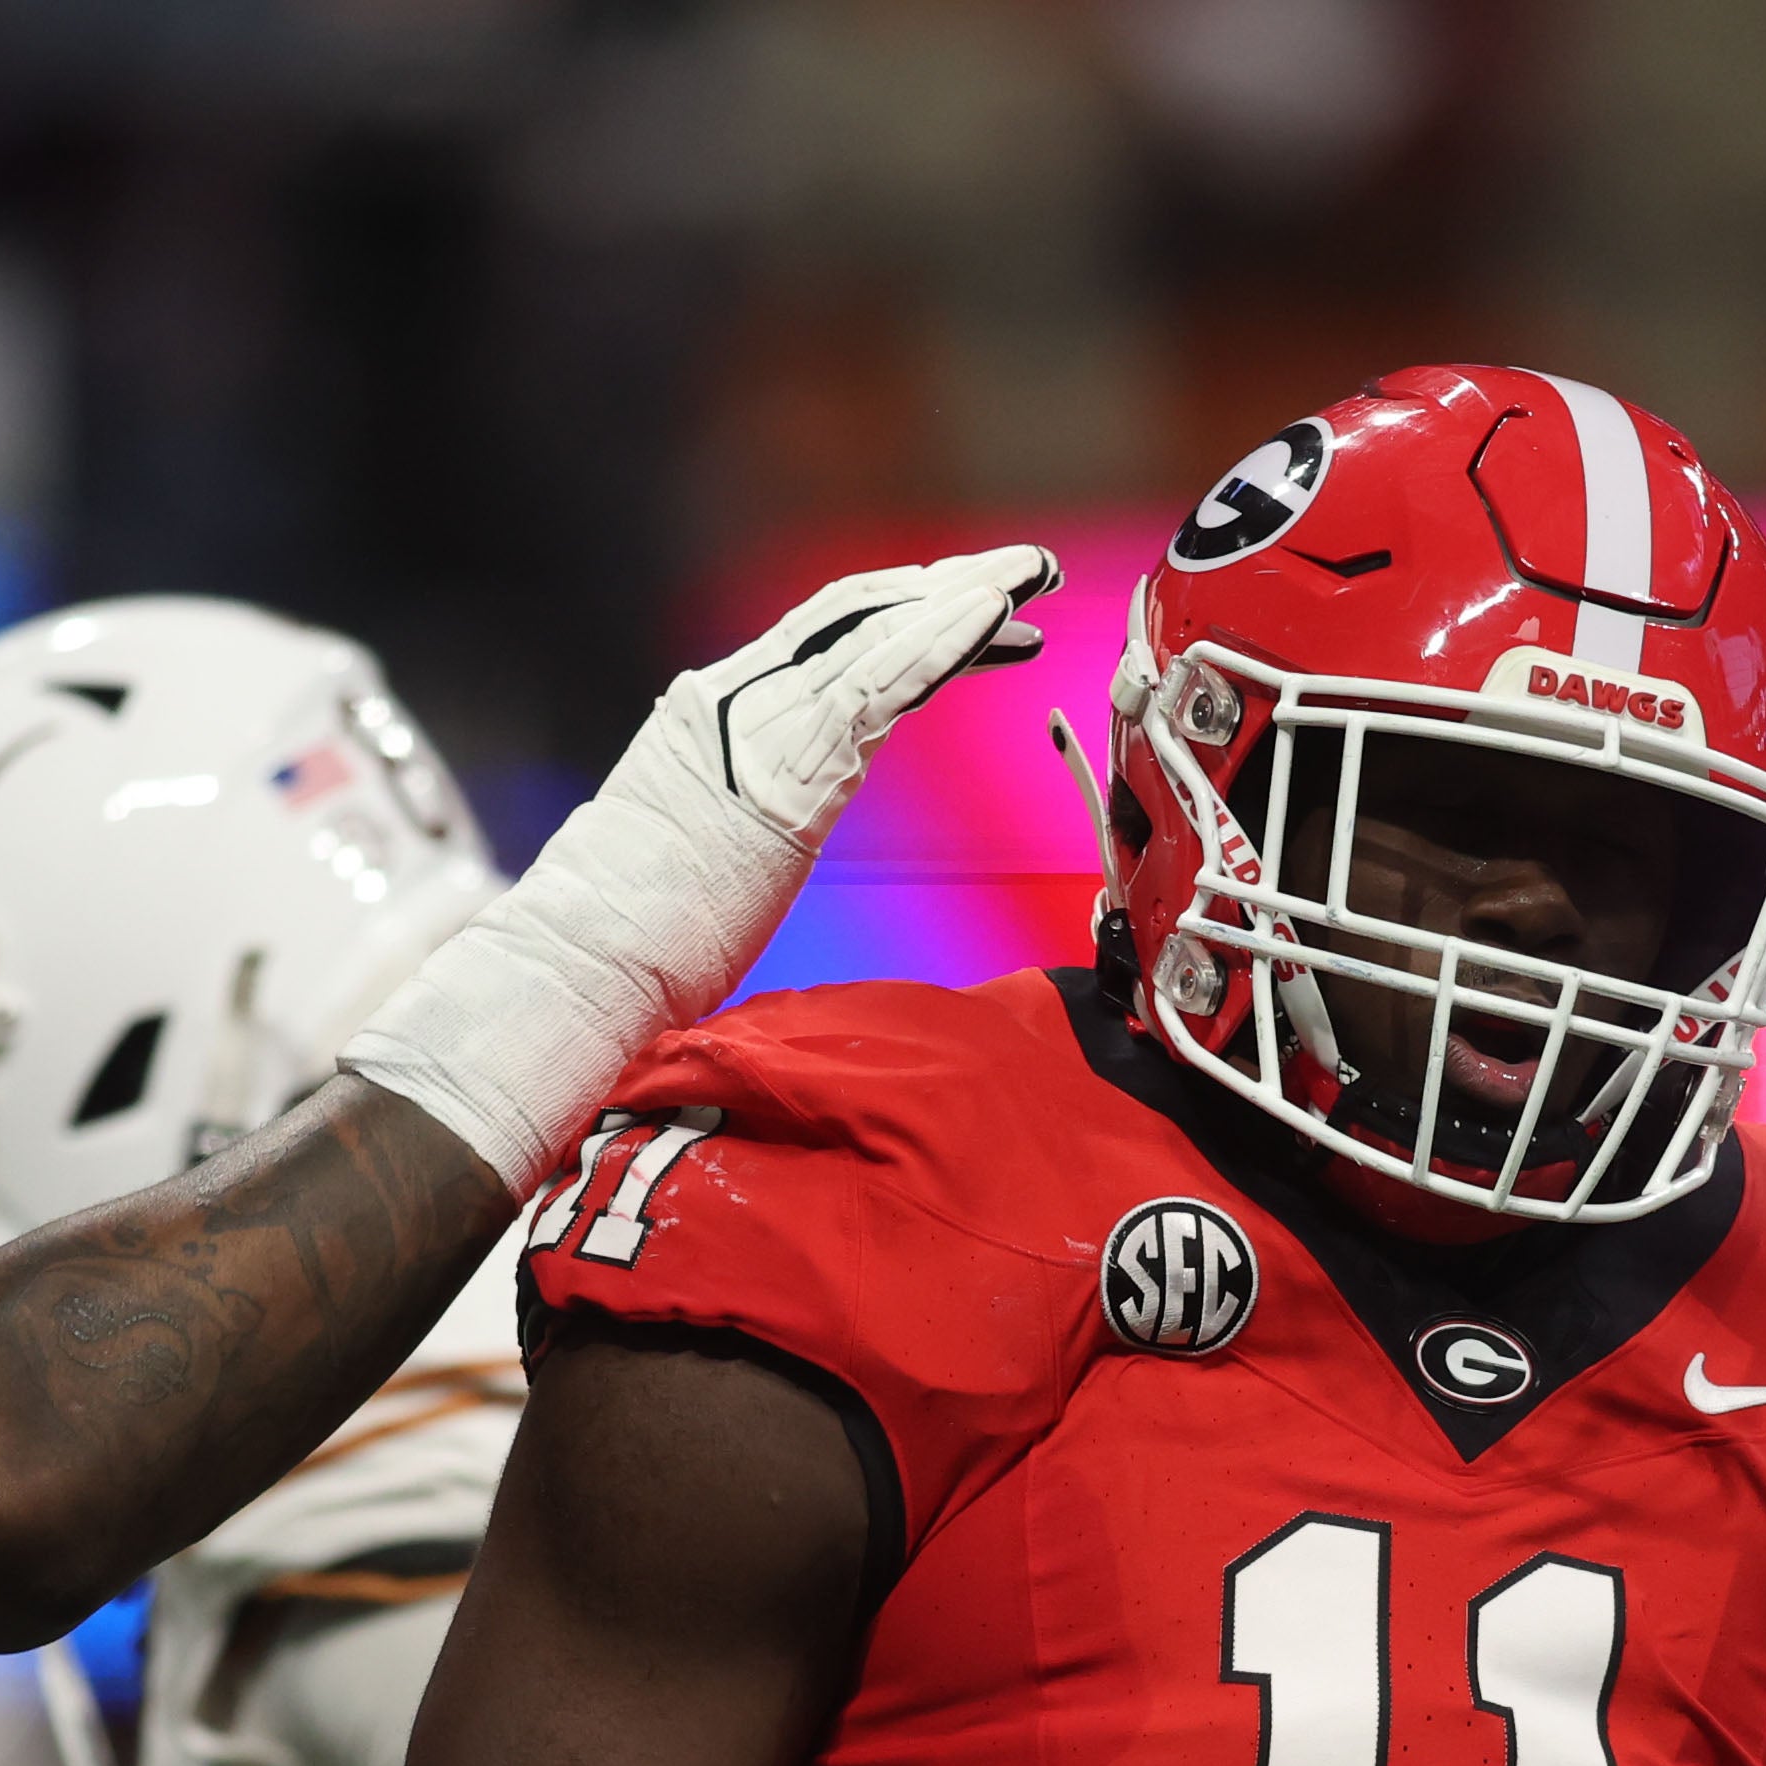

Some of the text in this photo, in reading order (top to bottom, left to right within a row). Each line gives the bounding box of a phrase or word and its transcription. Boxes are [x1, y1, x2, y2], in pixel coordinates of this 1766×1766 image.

[1167, 416, 1334, 573] G
[1527, 664, 1685, 730] DAWGS
[527, 1105, 729, 1271] 11
[1115, 1210, 1243, 1348] SEC
[1415, 1319, 1534, 1405] G
